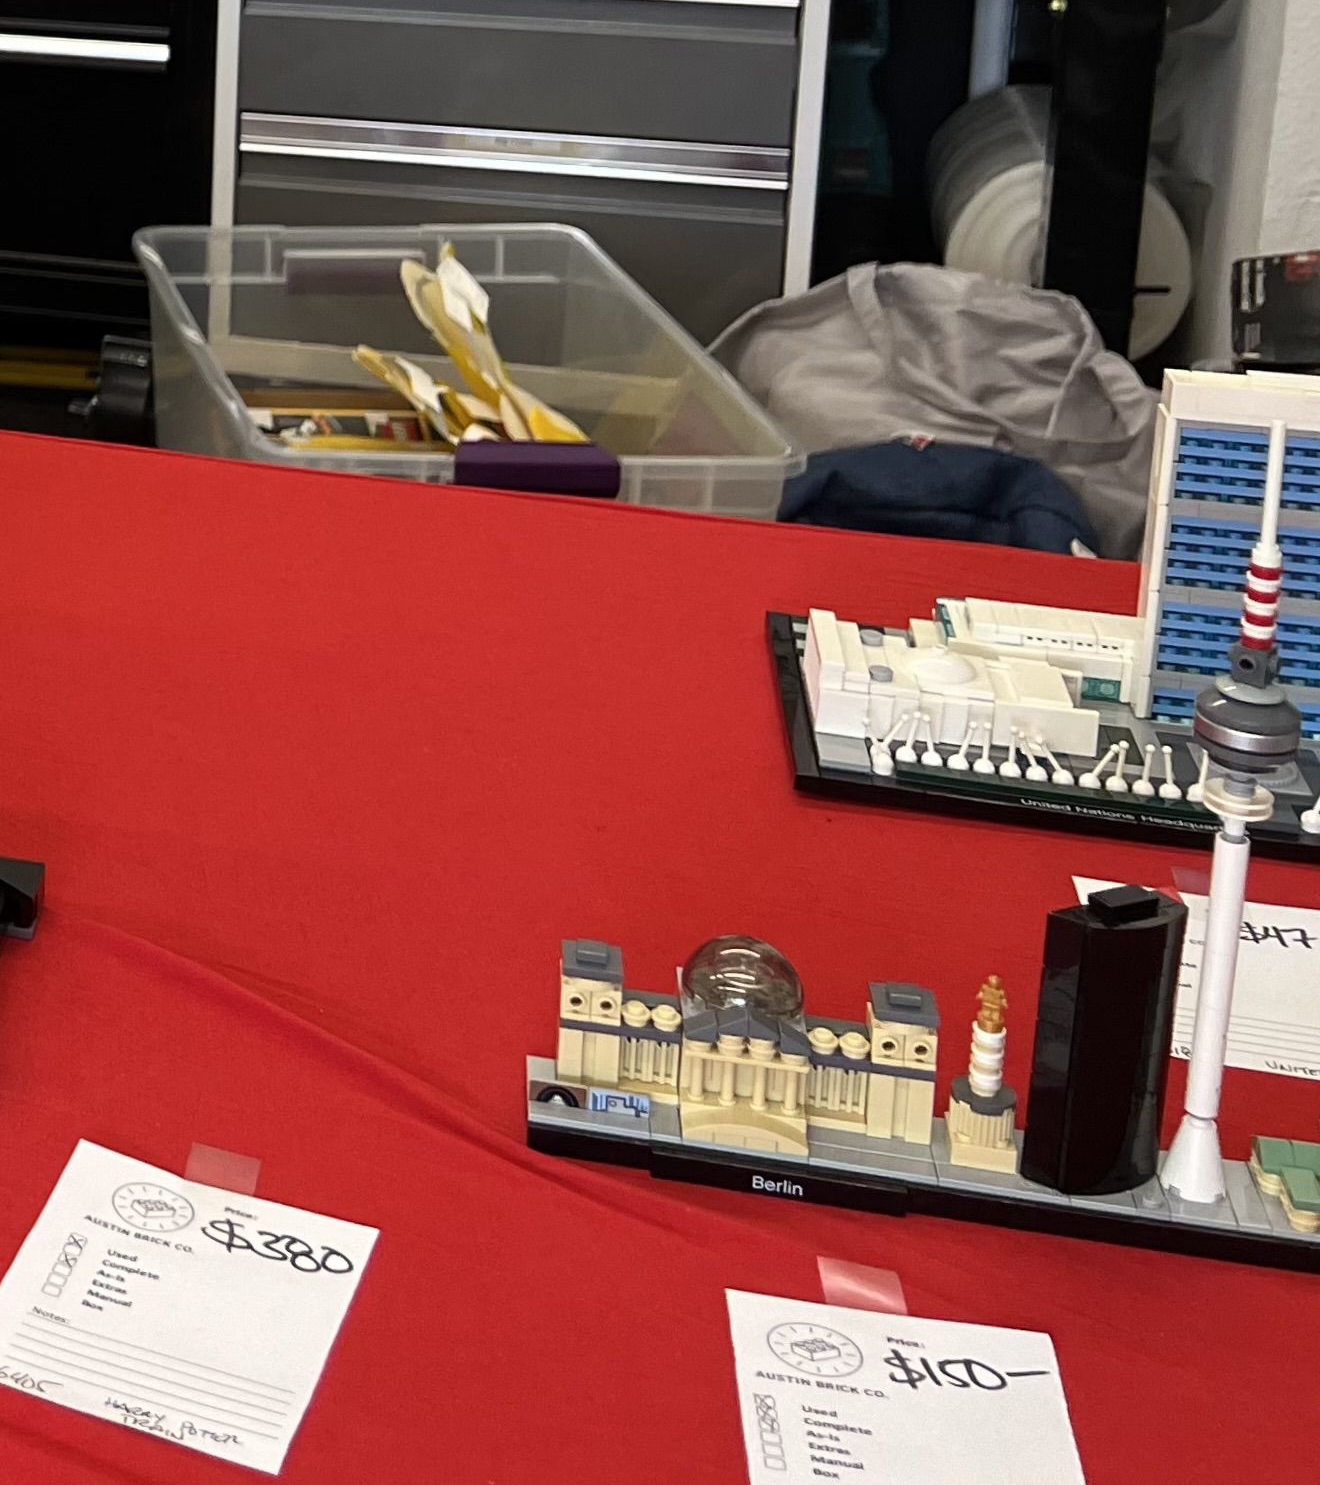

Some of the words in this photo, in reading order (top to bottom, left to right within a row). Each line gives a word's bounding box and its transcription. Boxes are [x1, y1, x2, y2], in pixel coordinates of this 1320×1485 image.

[1019, 797, 1072, 813] United
[1075, 804, 1137, 821] Nations
[1240, 921, 1319, 949] $47
[752, 1175, 805, 1199] Berlin
[223, 1205, 259, 1221] Price:
[83, 1213, 131, 1237] AUSTIN
[132, 1230, 173, 1249] BRICK
[174, 1241, 196, 1255] CO.
[106, 1248, 139, 1263] Used
[201, 1218, 355, 1275] $380
[101, 1258, 161, 1281] Complete
[91, 1278, 129, 1296] Extras
[81, 1299, 104, 1313] Box
[86, 1288, 133, 1308] Manual
[32, 1305, 72, 1325] Notes:
[885, 1335, 925, 1349] Price:
[755, 1369, 811, 1388] AUSTIN
[815, 1379, 860, 1395] BRICK
[863, 1387, 890, 1400] CO.
[104, 1395, 167, 1424] HARRY
[801, 1404, 838, 1418] Used
[120, 1413, 185, 1441] TRAIN
[803, 1416, 873, 1437] Complete
[807, 1441, 852, 1457] Extras
[810, 1453, 864, 1471] Manual
[812, 1466, 840, 1481] Box
